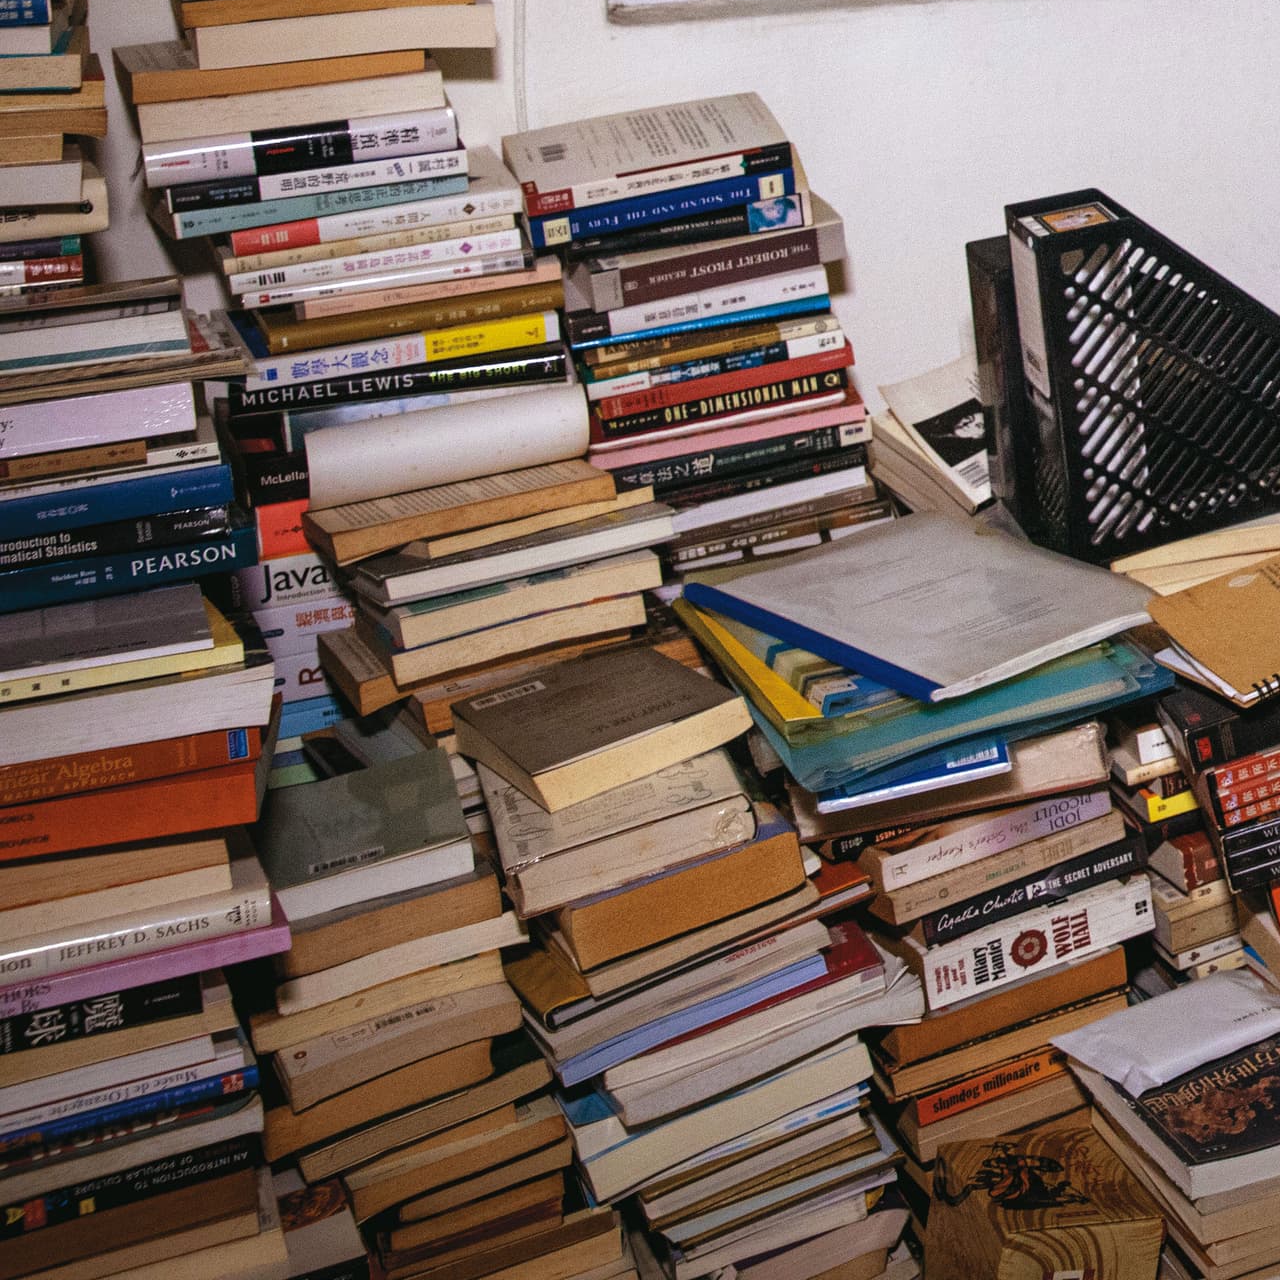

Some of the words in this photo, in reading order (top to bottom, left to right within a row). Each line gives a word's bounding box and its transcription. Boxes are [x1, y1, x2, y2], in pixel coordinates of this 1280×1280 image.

[651, 202, 677, 216] AND
[680, 194, 724, 209] SOUND
[689, 255, 733, 278] FROST
[736, 246, 789, 271] ROBERT
[290, 348, 389, 380] 數學大觀念
[241, 385, 338, 406] MICHAEL
[349, 373, 414, 394] LEWIS
[791, 376, 818, 396] MAN
[174, 518, 210, 531] PEARSON
[45, 541, 98, 558] Statistics
[131, 543, 237, 577] PEARSON
[261, 562, 330, 604] Java
[59, 756, 133, 780] Algebra
[1033, 792, 1093, 822] PICOULT
[1049, 811, 1082, 831] JODI
[1063, 868, 1091, 886] SECRET
[1093, 852, 1133, 875] ADVERSARY
[936, 901, 981, 932] Agatha
[981, 887, 1025, 916] Christie
[59, 934, 128, 961] JEFFREY
[134, 930, 151, 944] D.
[156, 917, 210, 939] SACHS
[1052, 915, 1073, 960] WOLF
[1067, 909, 1093, 952] HALL
[973, 942, 991, 986] Hilary
[986, 938, 1007, 983] Mantel
[933, 1082, 981, 1114] slumdog
[982, 1061, 1041, 1094] millionaire
[126, 1160, 174, 1179] POPULAR
[152, 1155, 231, 1185] INTRODUCTION
[235, 1151, 248, 1163] AN
